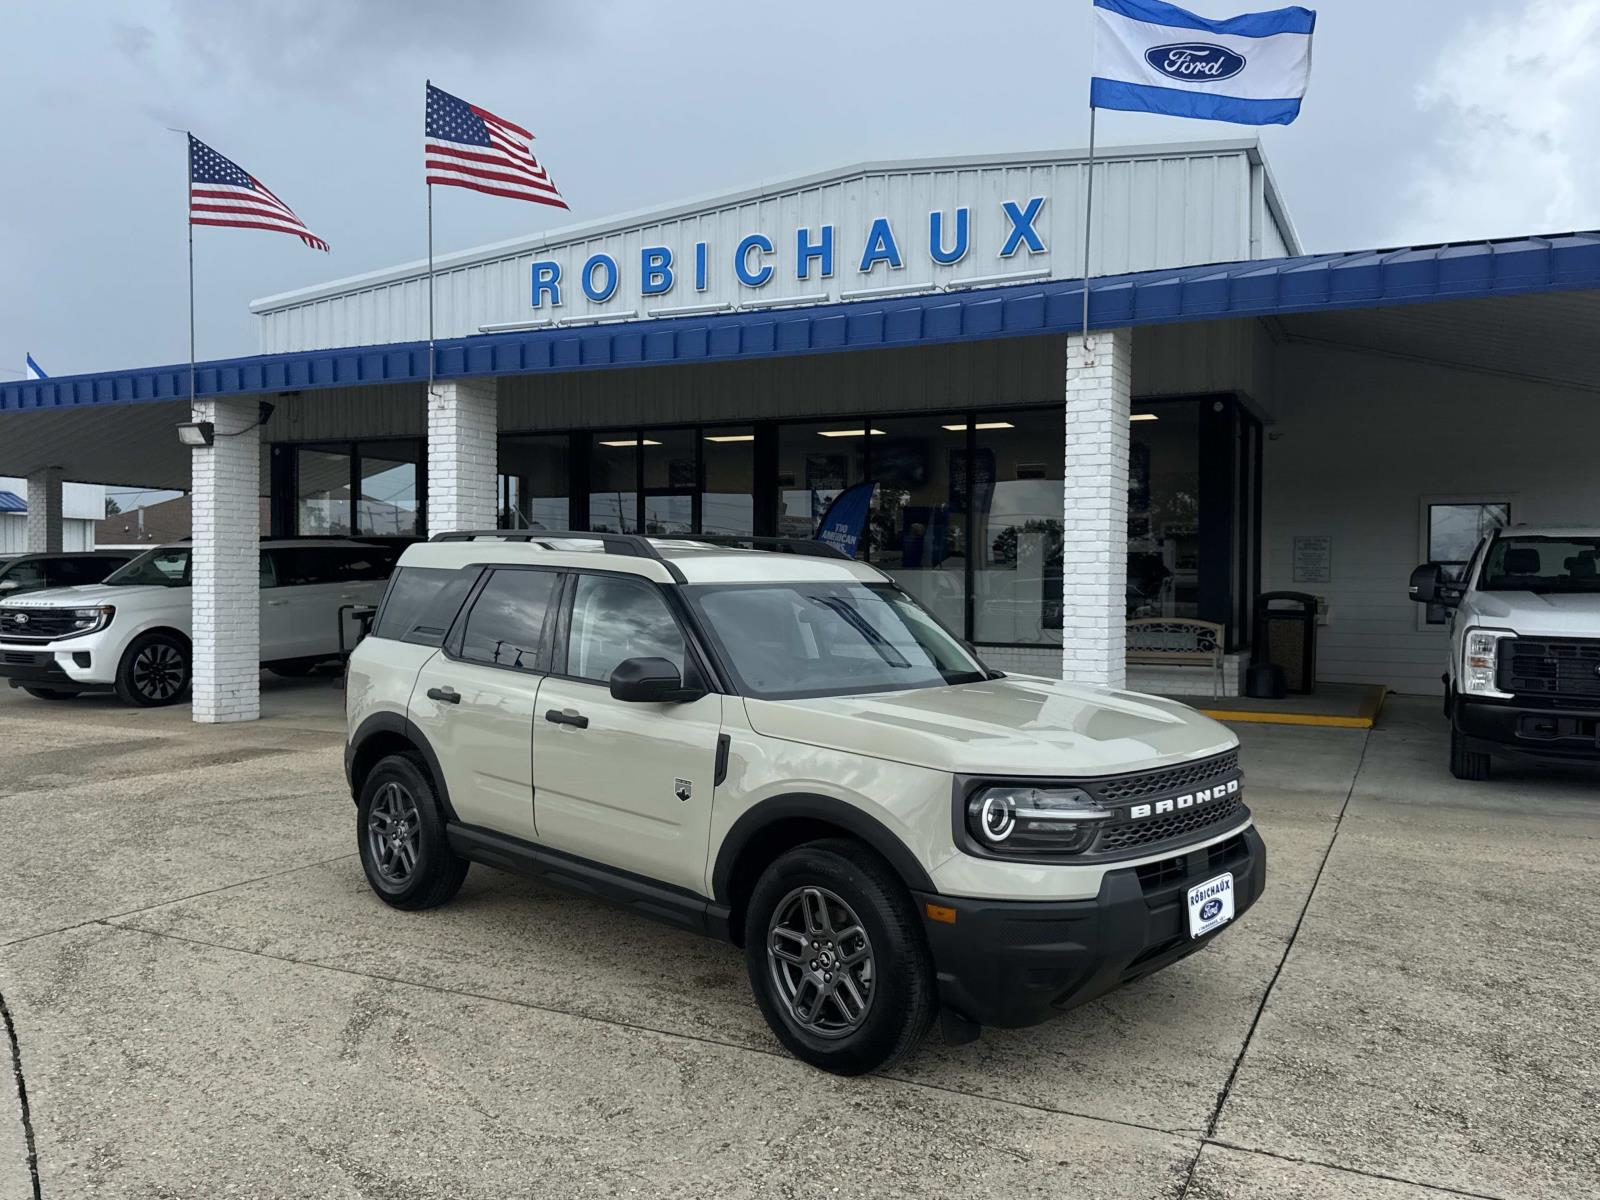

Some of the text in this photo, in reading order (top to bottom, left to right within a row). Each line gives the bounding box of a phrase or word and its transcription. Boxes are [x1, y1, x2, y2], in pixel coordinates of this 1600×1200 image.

[1164, 49, 1225, 75] Ford
[531, 197, 1048, 308] ROBICHAUX
[822, 529, 857, 545] AMERICAN
[1130, 780, 1239, 819] BRONCO
[1190, 879, 1231, 906] ROBICHAUX
[1203, 901, 1220, 919] Ford
